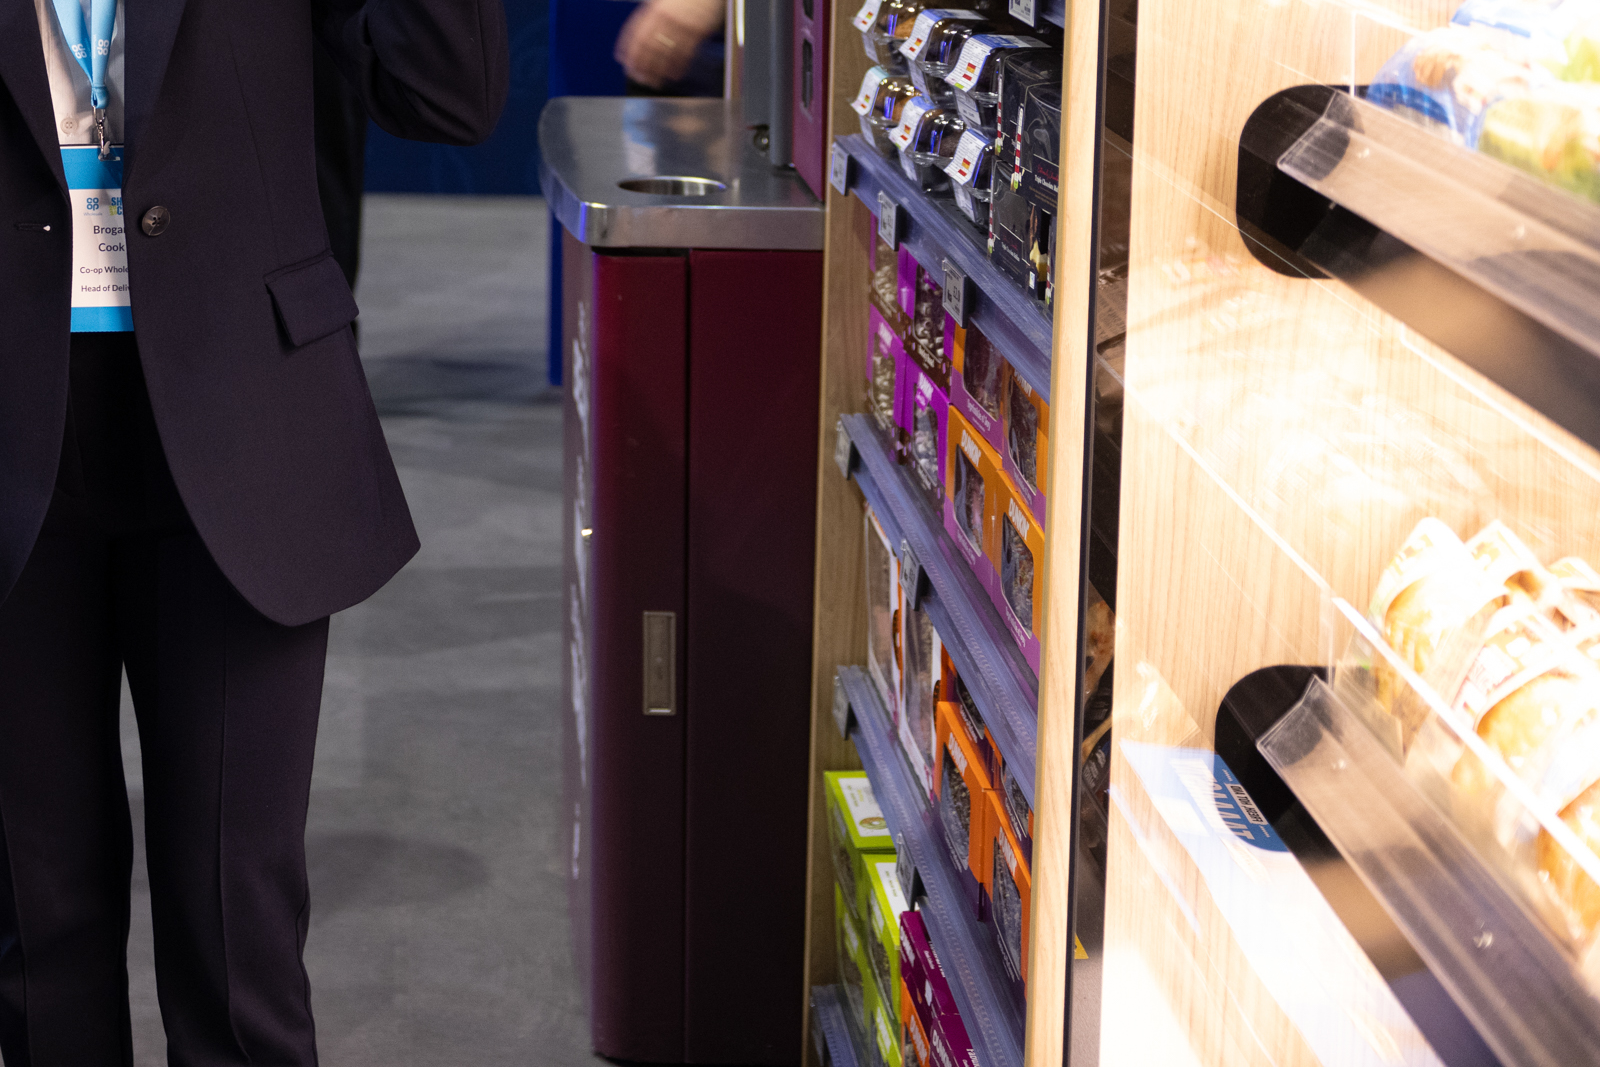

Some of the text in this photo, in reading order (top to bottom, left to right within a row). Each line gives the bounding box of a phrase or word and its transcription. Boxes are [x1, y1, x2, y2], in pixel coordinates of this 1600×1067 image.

[93, 225, 125, 236] Broga
[98, 242, 125, 252] Cook
[80, 266, 103, 275] Co-op
[81, 285, 101, 293] Head
[102, 284, 110, 292] of
